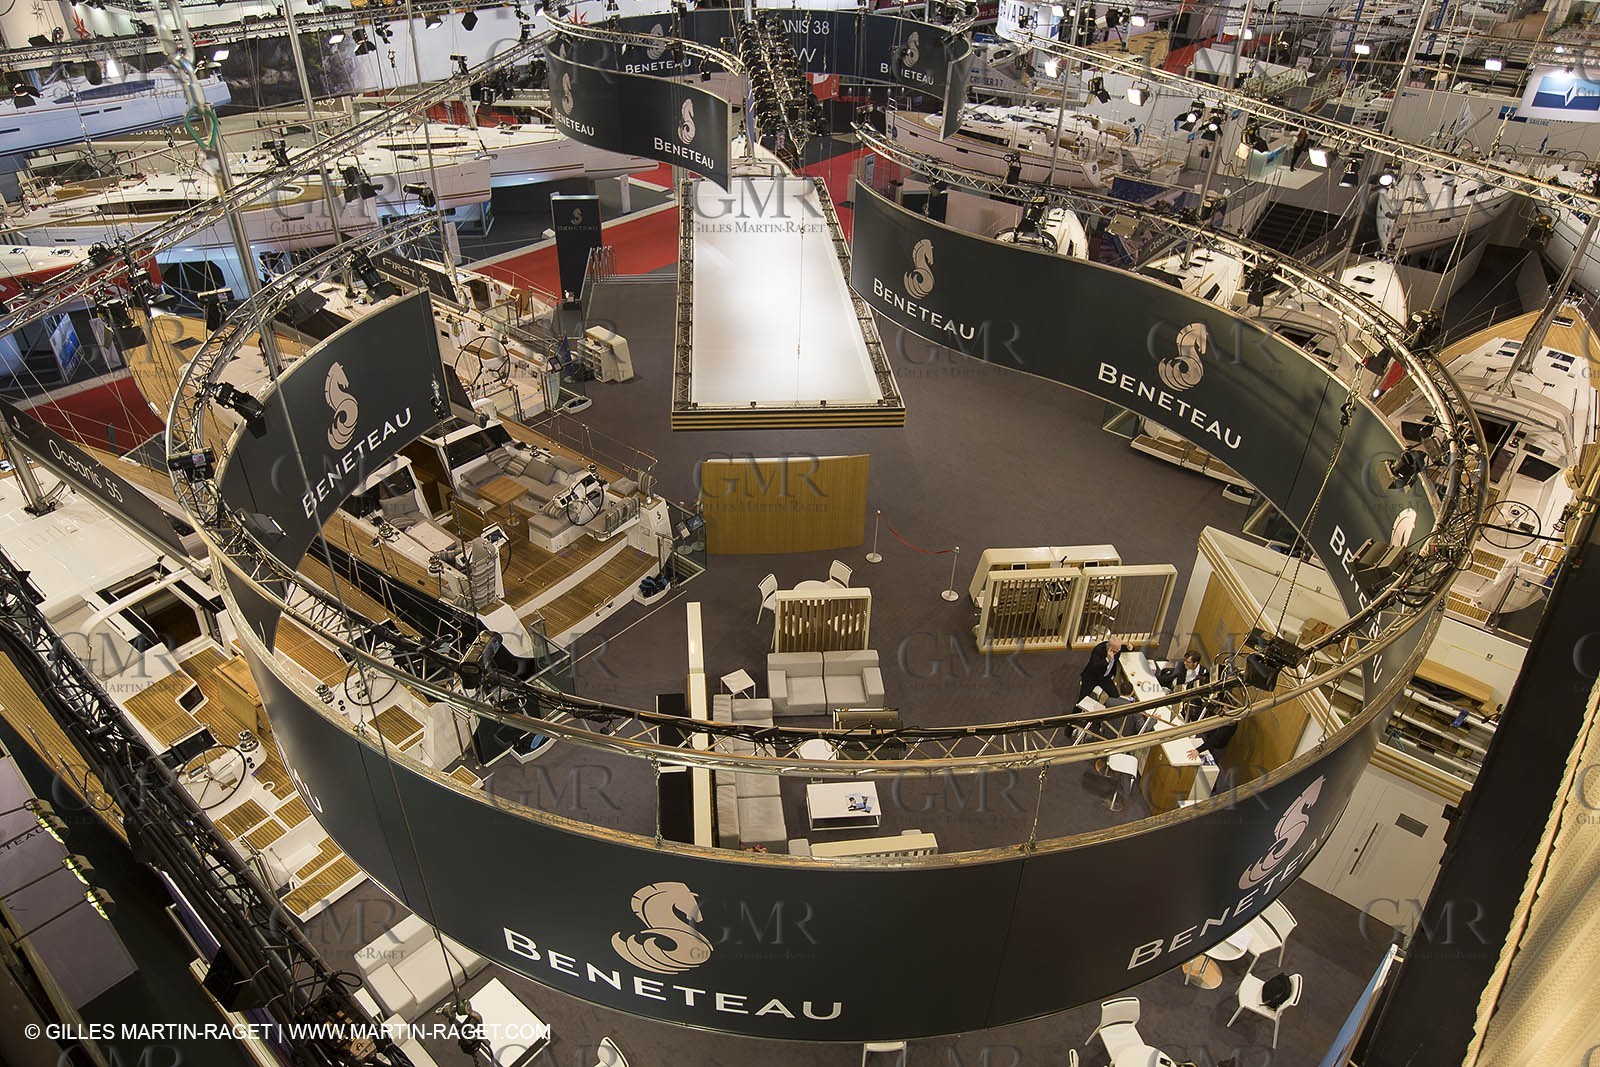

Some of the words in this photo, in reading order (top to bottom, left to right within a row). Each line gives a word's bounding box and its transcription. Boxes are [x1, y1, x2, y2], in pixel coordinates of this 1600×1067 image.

[813, 20, 830, 35] 38
[625, 59, 692, 75] BENETEU
[880, 62, 935, 86] BETEAU
[654, 136, 714, 169] BENETEAU
[382, 257, 415, 278] FIRST
[873, 277, 975, 341] BENETEAU
[1098, 362, 1242, 449] BENETEAU
[48, 439, 103, 489] Oceanis
[104, 477, 124, 503] 55
[302, 407, 412, 519] BENETEAU
[1127, 809, 1342, 971] BENETEAU
[503, 927, 842, 1021] BENETEAU
